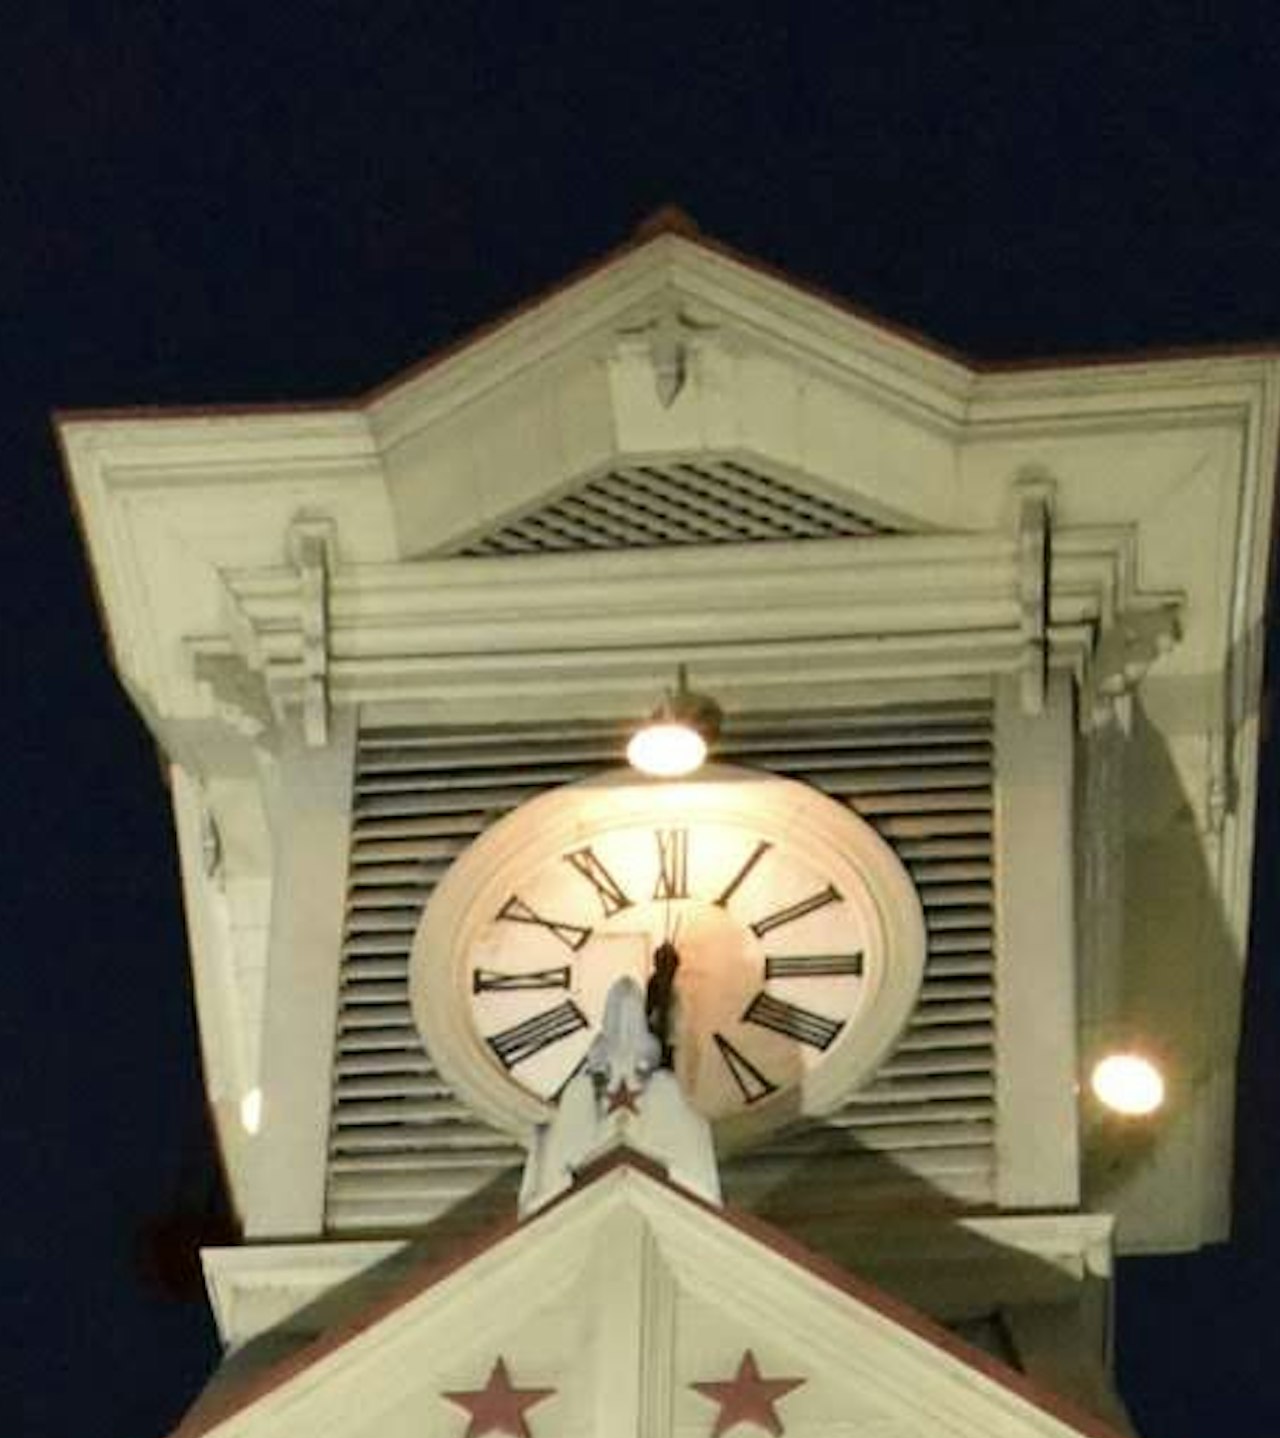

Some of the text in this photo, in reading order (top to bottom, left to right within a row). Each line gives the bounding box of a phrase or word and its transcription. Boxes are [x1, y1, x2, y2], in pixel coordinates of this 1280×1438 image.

[562, 846, 635, 918] XI
[652, 828, 691, 900] XII
[495, 894, 593, 951] X
[473, 965, 572, 995] IX
[764, 950, 864, 981] III
